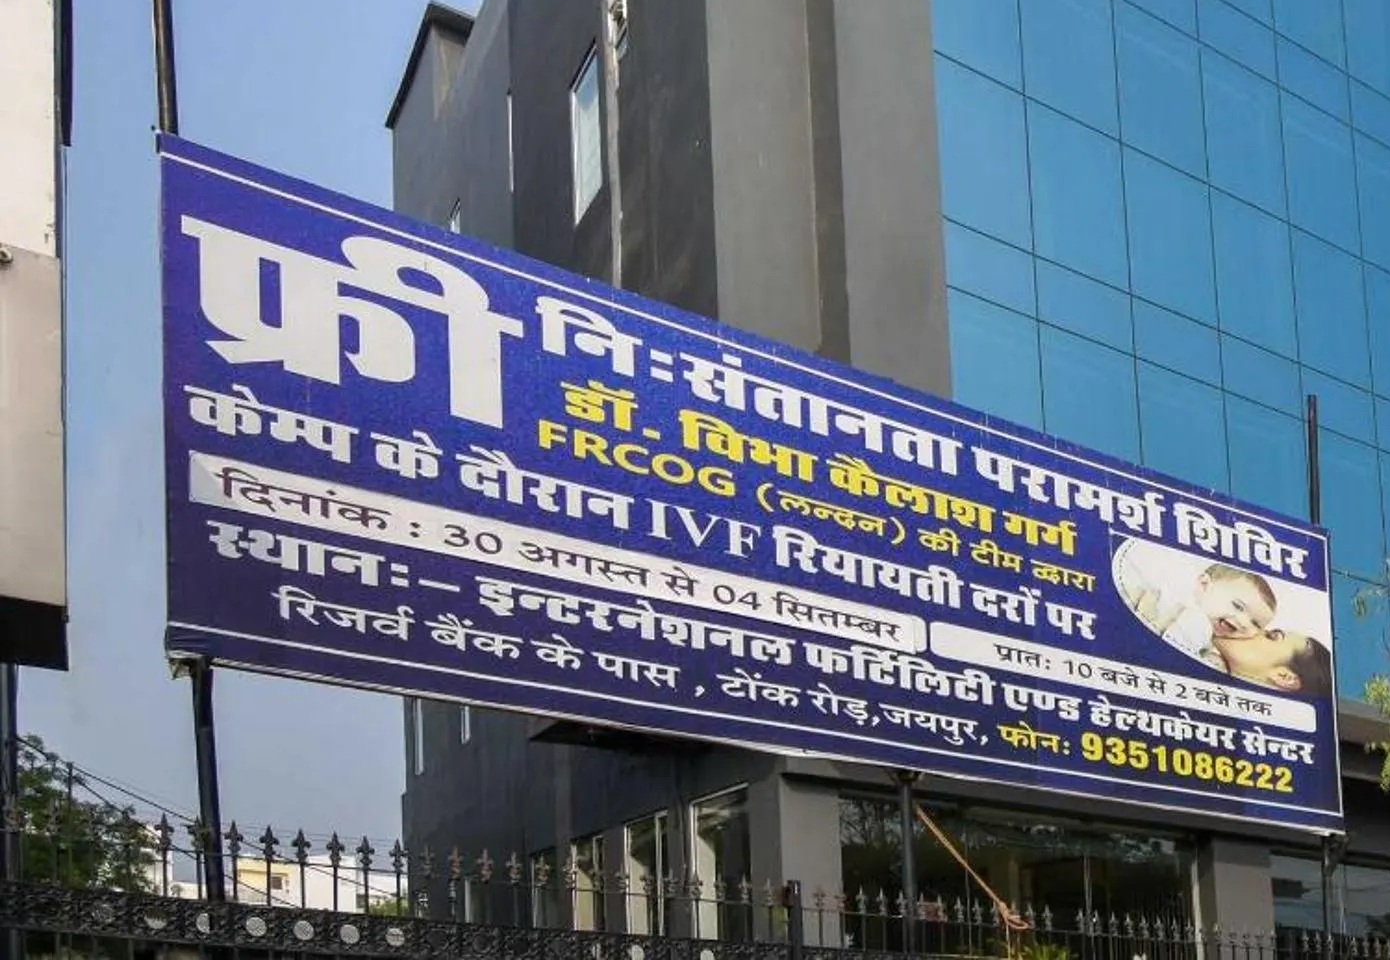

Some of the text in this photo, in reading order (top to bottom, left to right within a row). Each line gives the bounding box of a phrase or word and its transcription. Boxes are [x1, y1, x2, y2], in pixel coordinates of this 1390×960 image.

[181, 214, 524, 429] फ्री
[214, 467, 392, 529] दिनांक
[443, 523, 503, 556] 30
[517, 541, 650, 589] अगस्त
[662, 565, 701, 598] से
[711, 583, 762, 611] 04
[770, 591, 901, 641] सितम्बर
[370, 431, 443, 478] के
[455, 445, 635, 530] दौरान
[644, 497, 762, 560] IVF
[771, 524, 964, 610] रियायती
[968, 586, 1043, 626] दरों
[1044, 602, 1098, 641] पर
[538, 419, 736, 497] FRCOG
[916, 527, 961, 556] की
[968, 540, 1024, 573] टीम
[678, 408, 818, 482] विभा
[826, 452, 995, 533] कैलाश
[1001, 510, 1078, 556] गर्ग
[971, 444, 1166, 538] परामर्श
[1172, 501, 1310, 580] शिविर
[271, 585, 415, 641] रिजर्व
[424, 613, 524, 659] बैंक
[530, 633, 585, 670] के
[589, 651, 680, 688] पास
[716, 667, 801, 708] टोंक
[1081, 731, 1294, 793] 9351086222
[475, 576, 797, 667] इन्टरनेशनल
[803, 641, 996, 706] फर्टिलिटी
[1001, 681, 1082, 722] एण्ड
[1088, 694, 1236, 750] हेल्थकेयर
[1241, 726, 1315, 765] सेन्टर
[1062, 658, 1093, 680] 10
[1099, 666, 1140, 689] बजे
[1145, 673, 1167, 696] से
[1175, 683, 1188, 700] 2
[1192, 686, 1231, 709] बजे
[1235, 695, 1273, 717] तक
